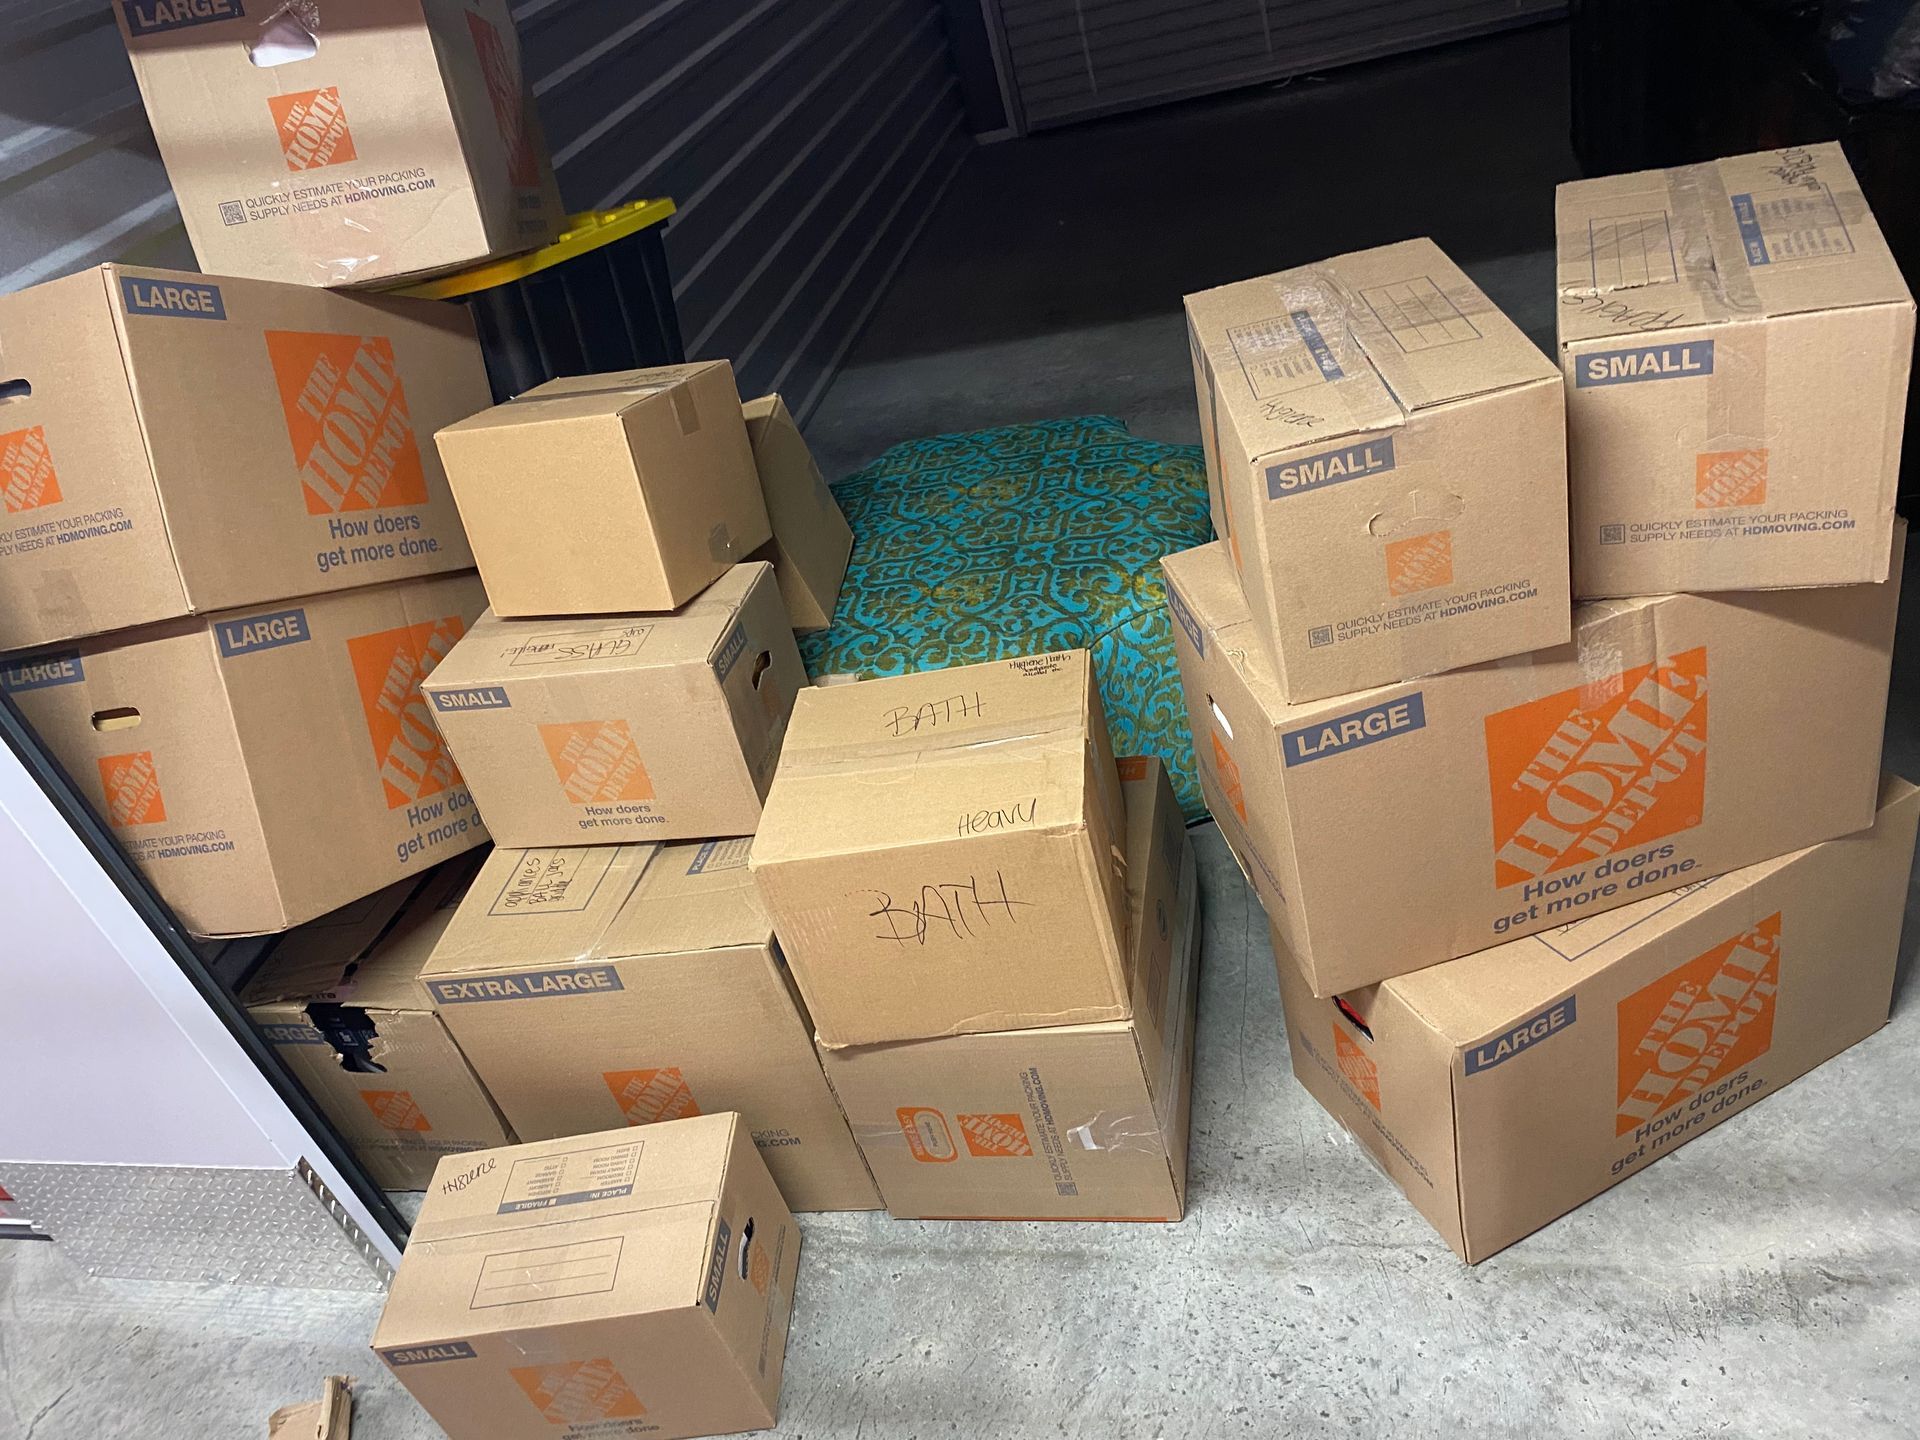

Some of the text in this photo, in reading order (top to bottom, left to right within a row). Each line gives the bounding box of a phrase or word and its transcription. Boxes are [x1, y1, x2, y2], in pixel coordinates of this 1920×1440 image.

[136, 0, 231, 28] LARGE
[282, 101, 308, 133] THE
[285, 88, 341, 170] HOME
[316, 113, 347, 166] DEPOT
[245, 167, 426, 209] QUICKLY ESTIMATE YOUR PACKING
[249, 178, 436, 221] SUPPLY NEEDS AT HDMOVING.COM
[133, 284, 216, 313] LARGE
[1589, 348, 1700, 380] SMALL
[297, 351, 341, 421] THE
[301, 337, 398, 512] HOME
[354, 399, 412, 508] DEPOT
[1279, 448, 1383, 490] SMALL
[1696, 451, 1767, 507] HOME
[15, 523, 56, 540] ESTIMATE
[56, 516, 84, 530] YOUR
[83, 507, 124, 525] PACKING
[15, 538, 45, 554] NEEDS
[45, 536, 56, 546] AT
[56, 520, 133, 545] HDMOVING.COM
[328, 514, 420, 540] How doers
[1629, 520, 1856, 543] SUPPLY NEEDS AT HDMOVING.COM
[1630, 509, 1848, 533] QUICKLY ESTIMATE YOUR PACKING
[317, 537, 442, 573] get more done.
[1336, 578, 1532, 632] QUICKLY ESTIMATE YOUR PACKING
[1337, 587, 1539, 642] SUPPLY NEEDS AT HDMOVING.COM
[225, 616, 301, 649] LARGE
[719, 631, 744, 674] SMALL
[8, 658, 75, 687] LARGE
[377, 646, 417, 717] THE
[438, 690, 503, 708] SMALL
[884, 691, 986, 737] BATH
[560, 731, 590, 762] THE
[1296, 703, 1411, 756] LARGE
[560, 720, 630, 802] HOME
[1497, 659, 1708, 878] HOME
[1512, 709, 1602, 793] THE
[585, 804, 651, 816] How doers
[1577, 727, 1707, 859] DEPOT
[406, 800, 444, 829] How
[579, 814, 670, 830] get more done.
[147, 850, 157, 860] AT
[158, 841, 235, 860] HDMOVING.COM
[159, 835, 185, 847] YOUR
[185, 829, 226, 844] PACKING
[397, 832, 425, 863] get
[428, 818, 468, 846] more
[1523, 843, 1674, 902] How doers
[867, 870, 1035, 947] BATH
[1494, 905, 1539, 934] get
[1546, 884, 1618, 915] more
[438, 971, 612, 999] EXTRA LARGE
[264, 1027, 320, 1041] ARGE
[1477, 1006, 1566, 1066] LARGE
[1616, 929, 1780, 1118] HOME
[1633, 981, 1702, 1056] THE
[1679, 972, 1777, 1091] DEPOT
[1019, 1071, 1035, 1102] PACKING
[1029, 1067, 1055, 1127] HDMOVING.COM
[1635, 1071, 1749, 1142] How doers
[1029, 1103, 1042, 1122] YOUR
[1611, 1078, 1768, 1175] get more done.
[1036, 1122, 1053, 1154] ESTIMATE
[1051, 1135, 1065, 1159] NEEDS
[515, 1200, 548, 1210] FRAGILE
[601, 1188, 628, 1198] PLACE
[710, 1234, 727, 1302] SMALL
[392, 1346, 467, 1365] SMALL
